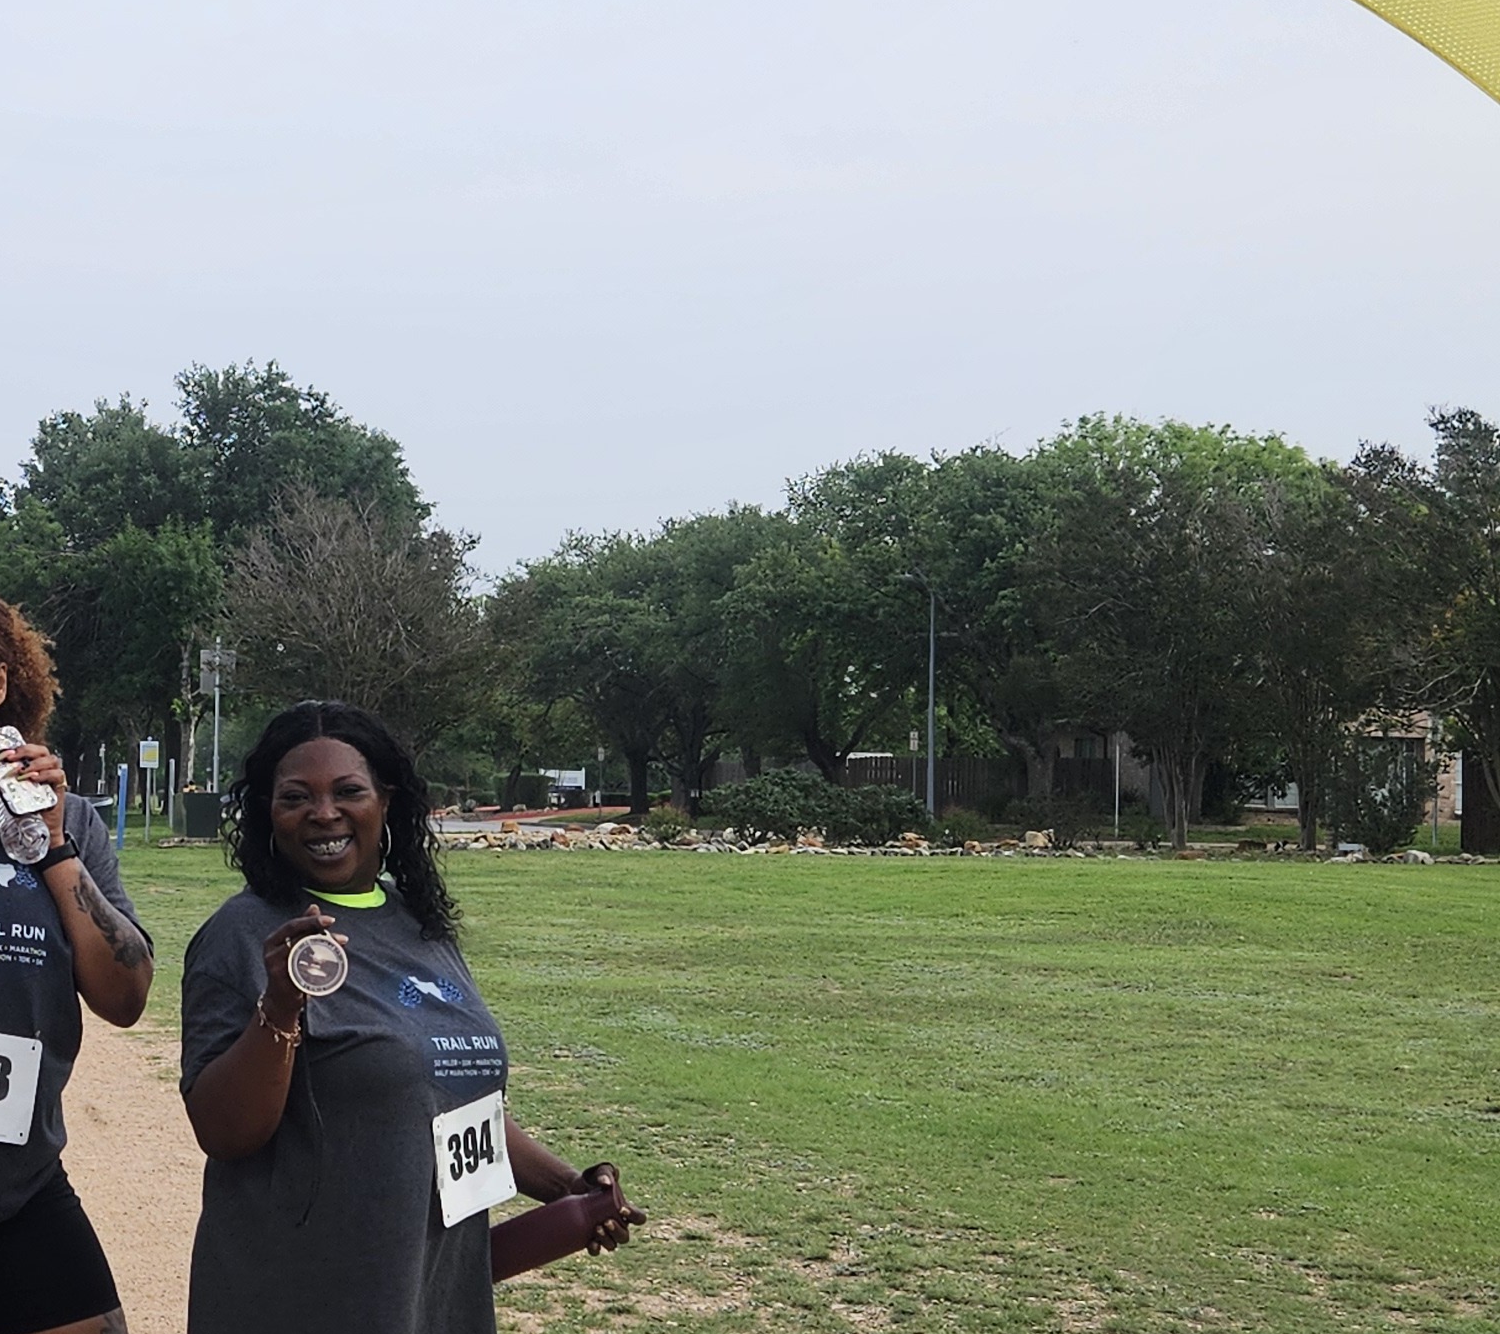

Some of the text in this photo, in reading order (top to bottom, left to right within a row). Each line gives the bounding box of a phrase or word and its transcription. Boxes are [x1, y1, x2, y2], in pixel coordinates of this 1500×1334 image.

[11, 923, 46, 942] RUN
[431, 1036, 499, 1051] TRAIL RUN
[447, 1118, 495, 1182] 394
